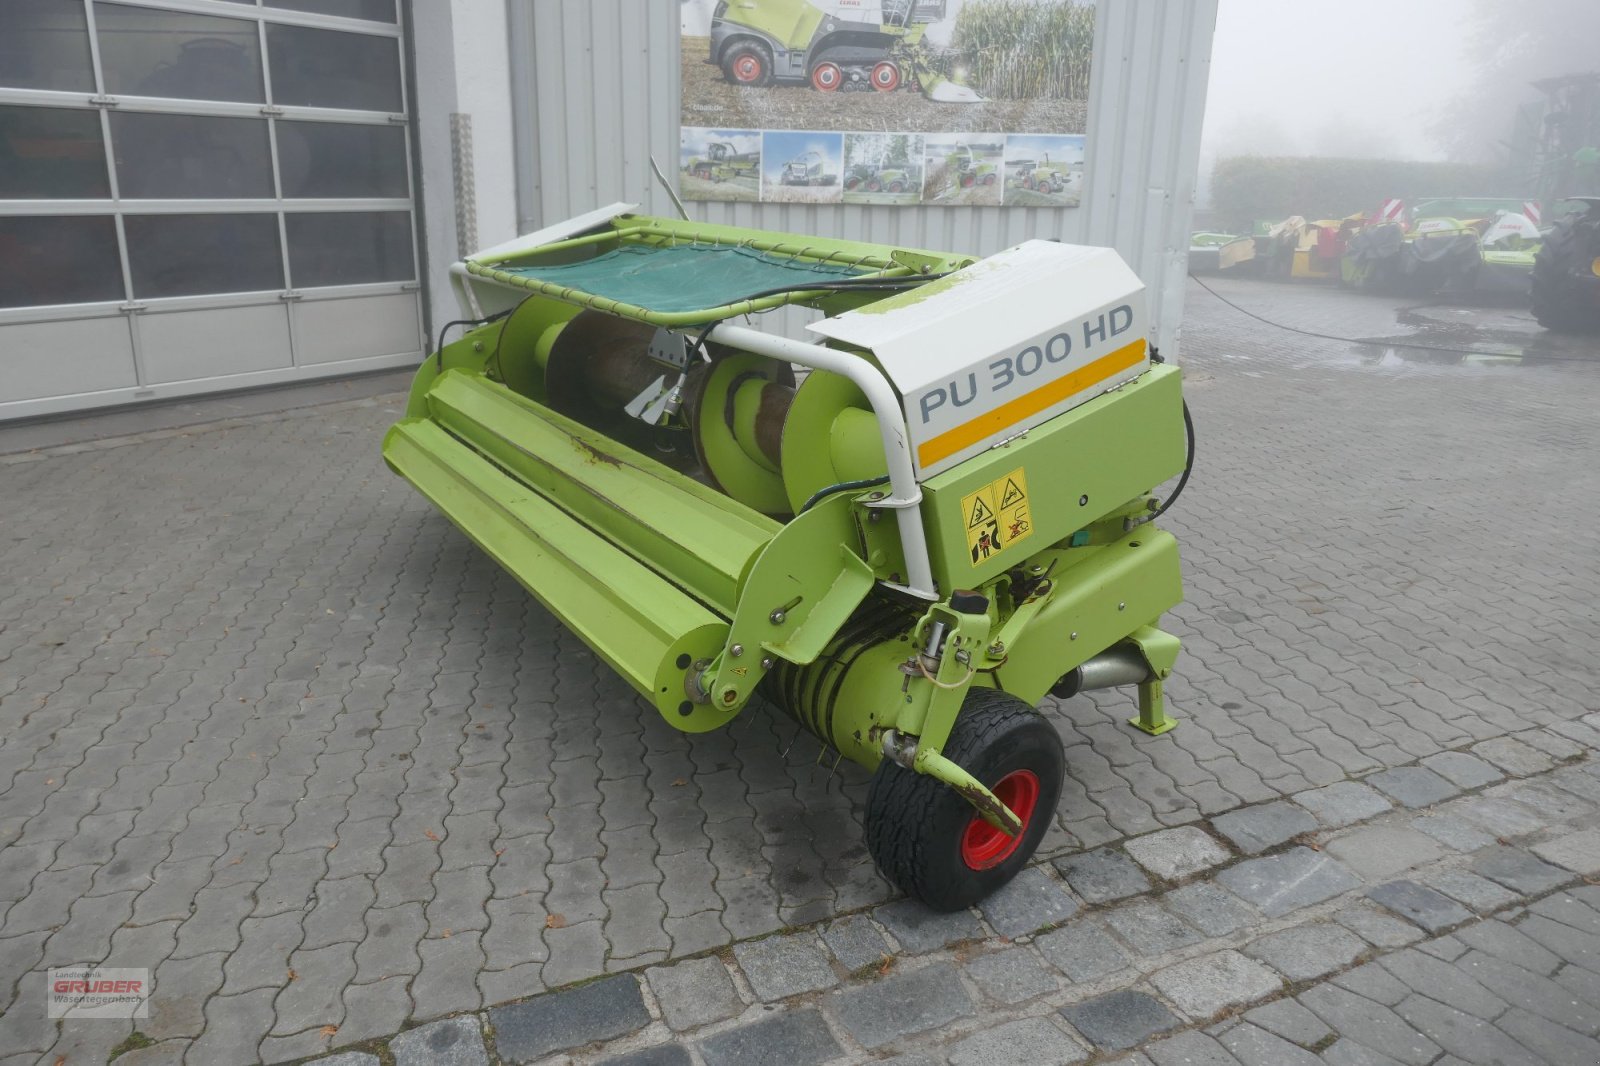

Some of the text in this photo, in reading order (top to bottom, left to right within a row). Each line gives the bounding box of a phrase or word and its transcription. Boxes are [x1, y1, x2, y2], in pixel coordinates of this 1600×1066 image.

[919, 304, 1133, 424] PU 300 HD
